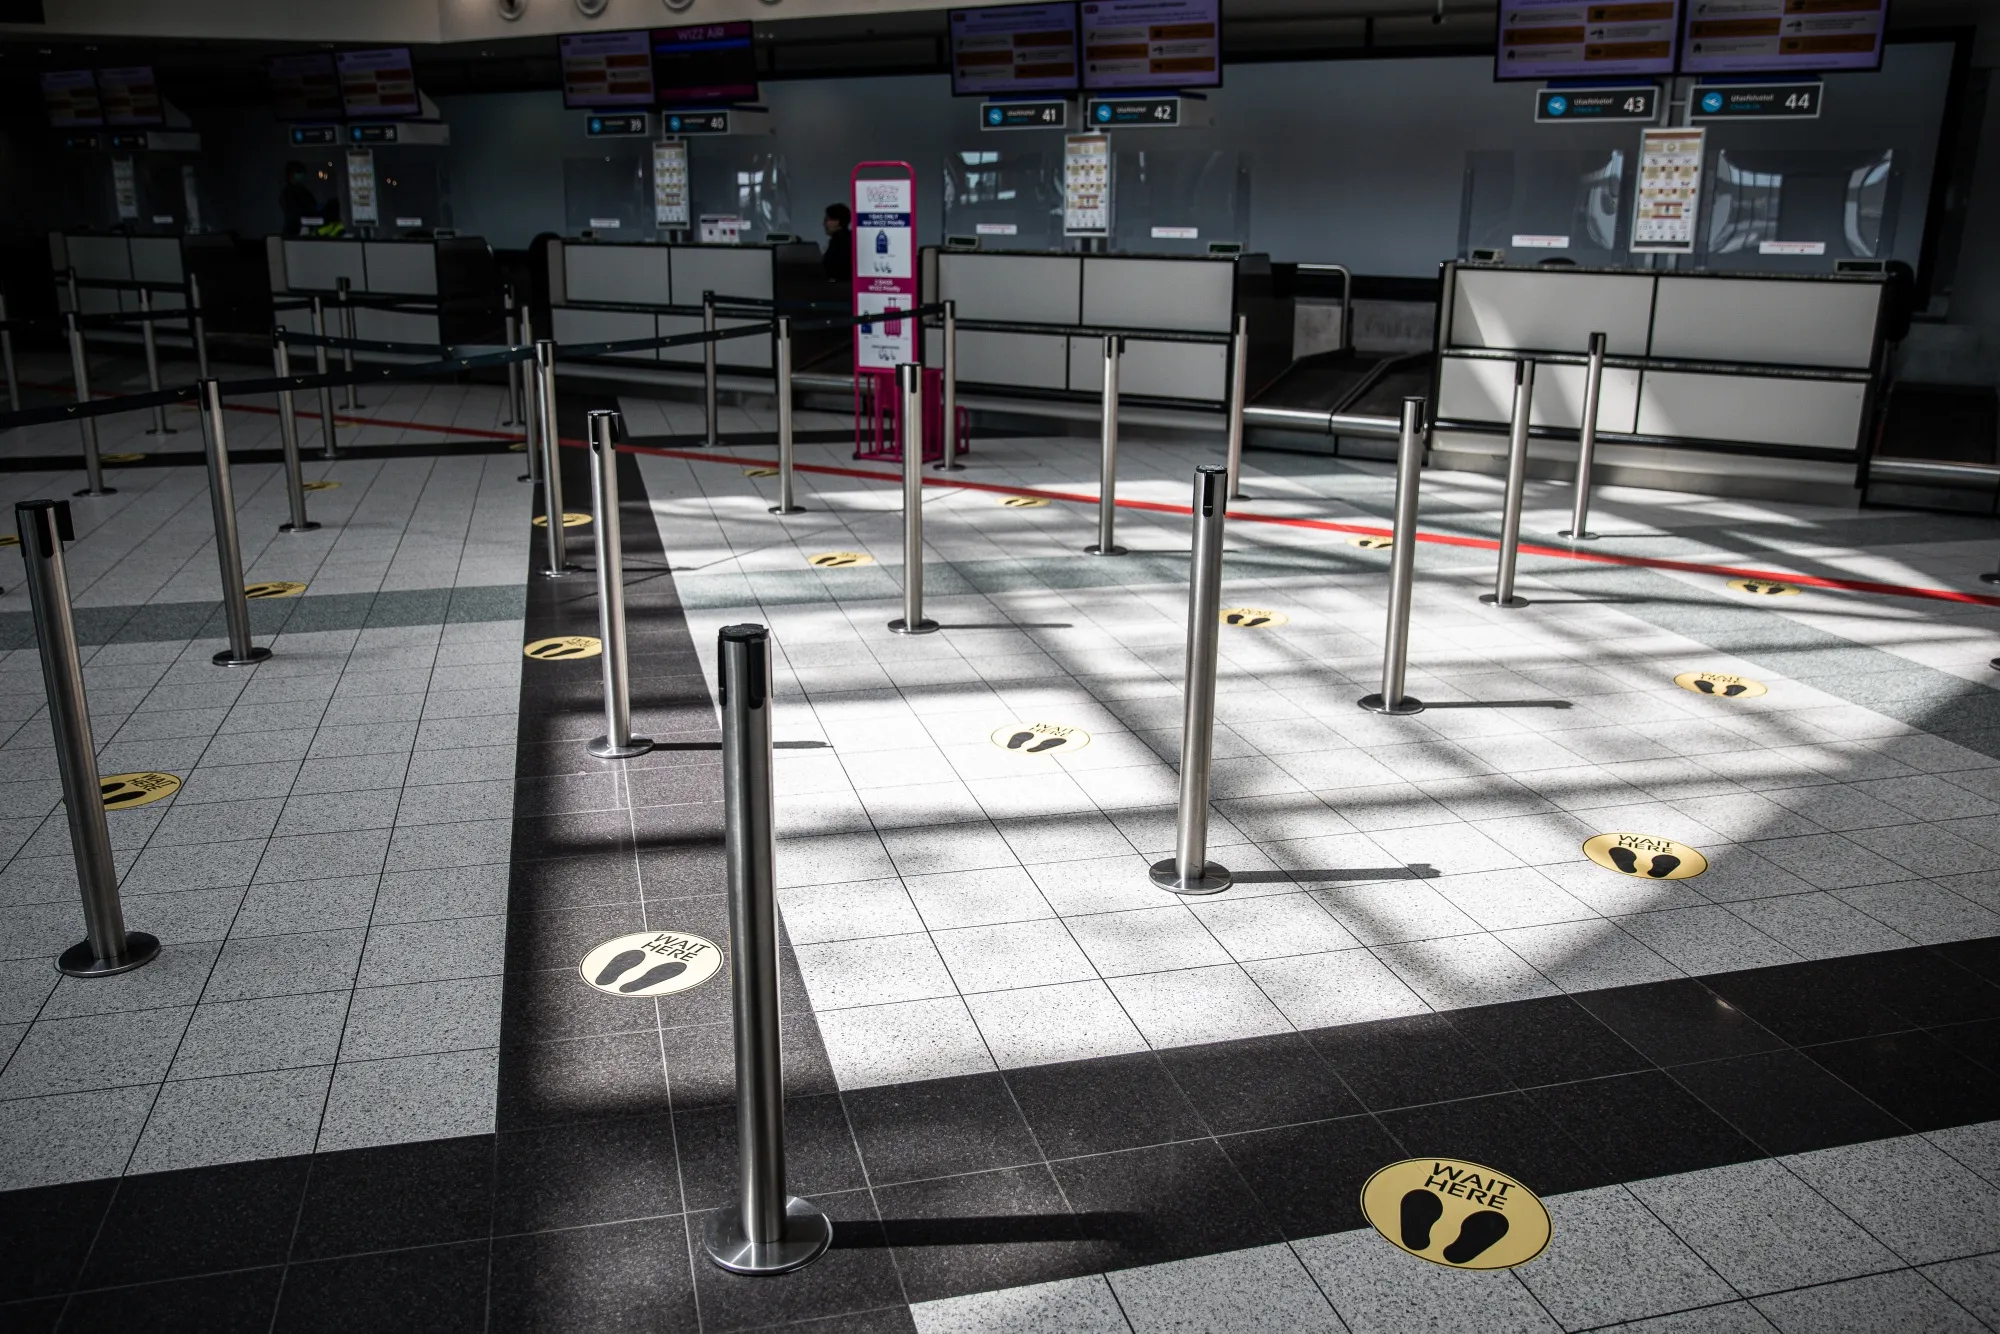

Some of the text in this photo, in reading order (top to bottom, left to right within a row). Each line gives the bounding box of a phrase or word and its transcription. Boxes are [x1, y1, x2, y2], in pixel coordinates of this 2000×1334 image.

[677, 26, 724, 41] WIZZ AIR
[1623, 96, 1646, 113] 43
[1784, 93, 1810, 110] 44
[1041, 108, 1056, 122] 41
[1154, 105, 1171, 120] 42
[630, 118, 642, 132] 39
[710, 116, 724, 130] 40
[126, 777, 162, 792] HERE
[141, 773, 177, 787] WAIT
[1618, 841, 1673, 854] HERE
[1619, 834, 1674, 847] WAIT
[654, 933, 711, 953] WAIT
[641, 941, 697, 962] HERE
[1433, 1162, 1515, 1196] WAIT
[1424, 1175, 1508, 1210] HERE
